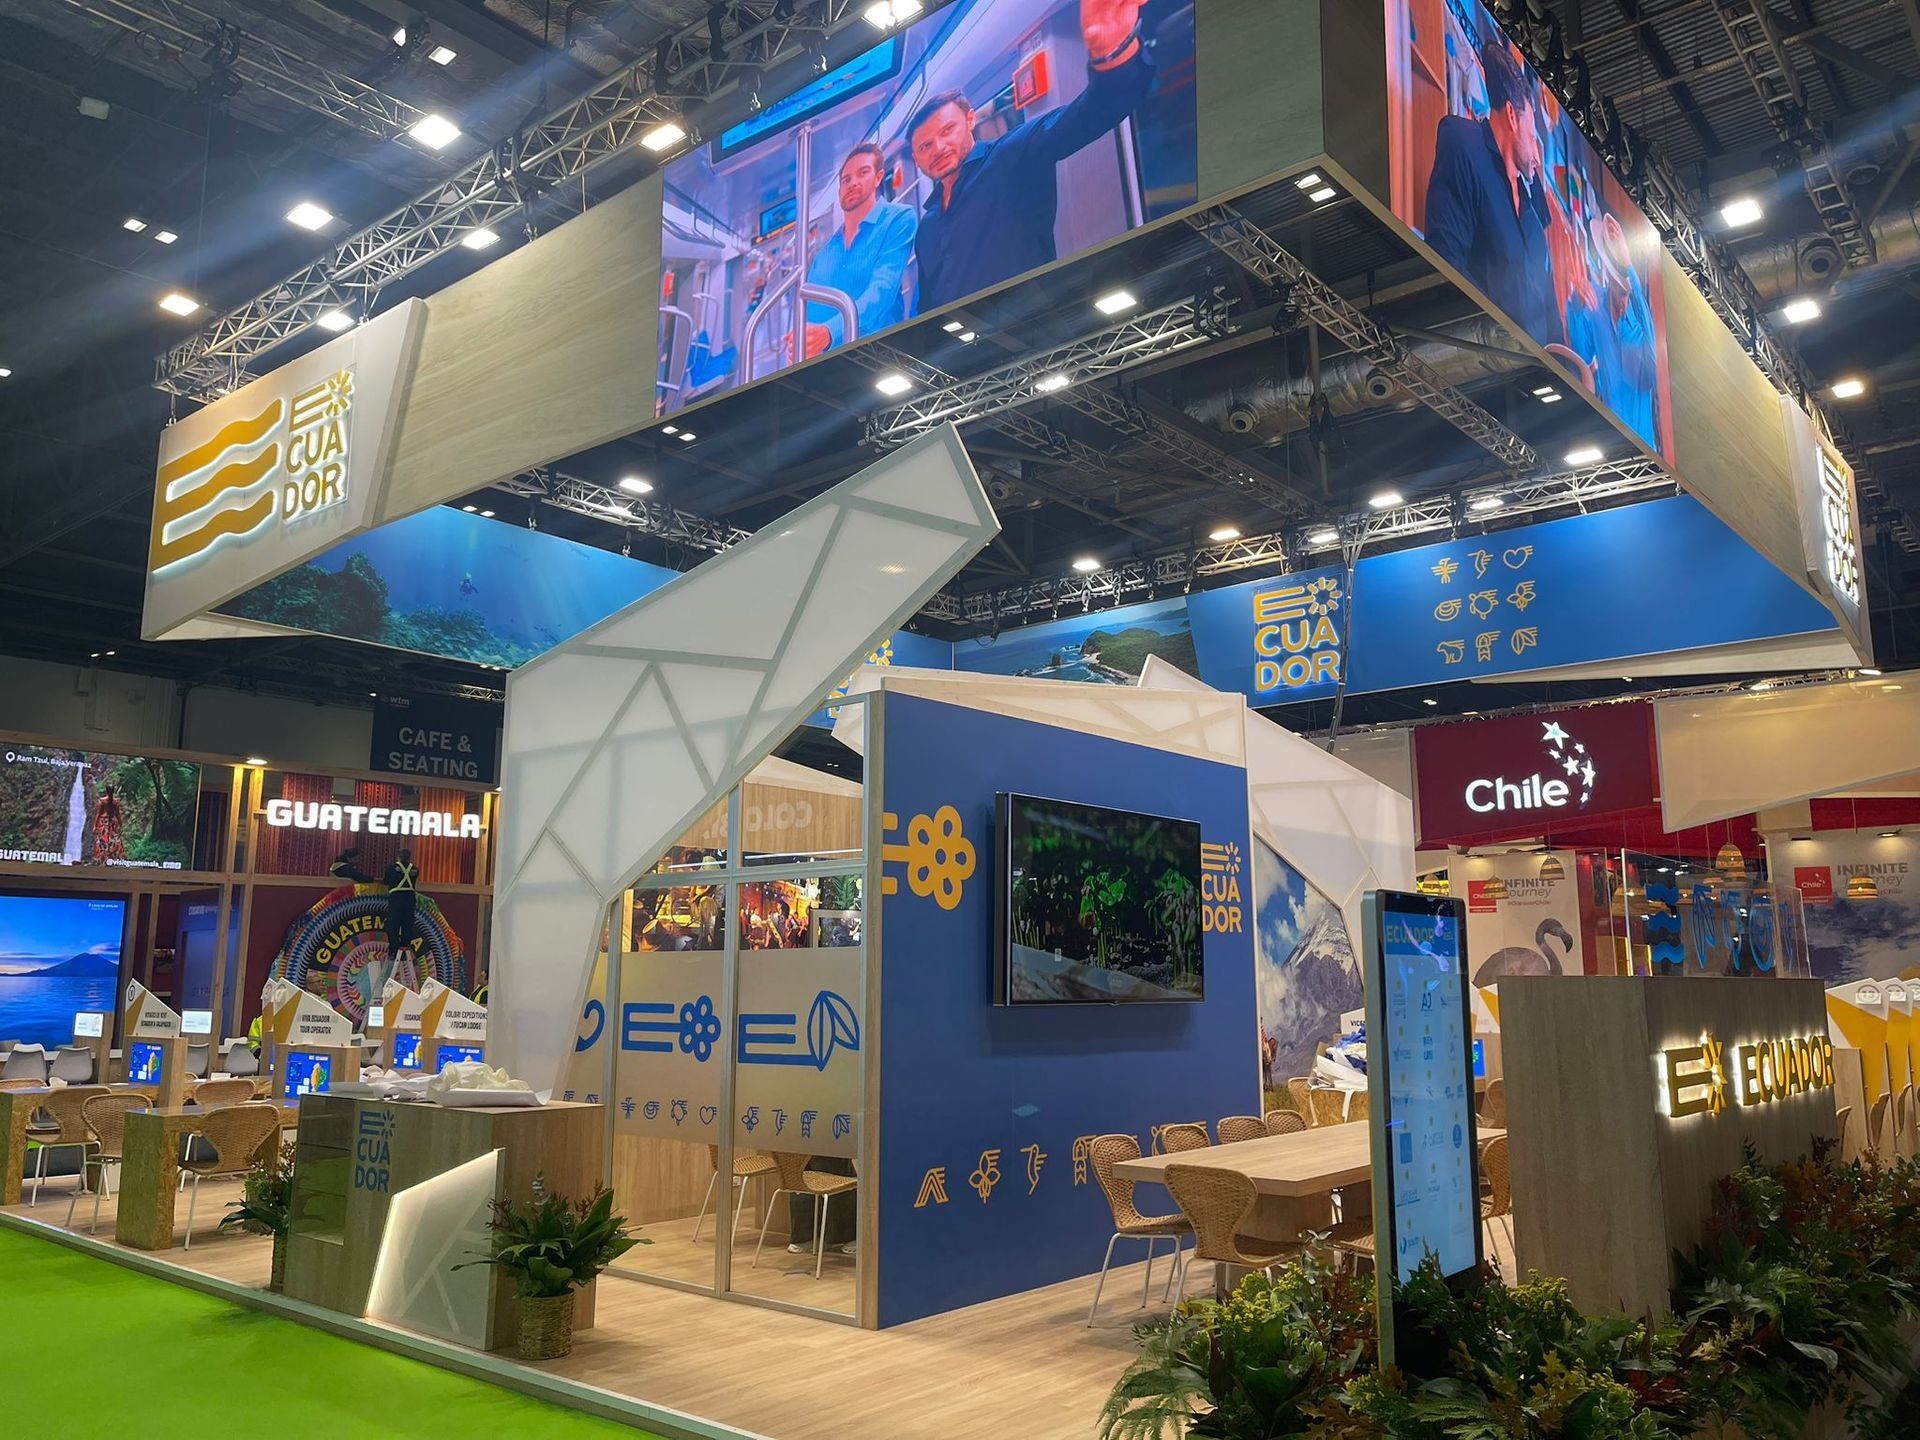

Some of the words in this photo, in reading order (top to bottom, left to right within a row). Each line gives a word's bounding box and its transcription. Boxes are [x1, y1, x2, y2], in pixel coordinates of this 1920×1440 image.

[1254, 616, 1340, 657] CUA
[1254, 650, 1341, 692] DOR
[399, 727, 453, 751] CAFE
[457, 735, 472, 753] &
[388, 751, 479, 779] SEATING
[1465, 773, 1569, 813] Chile
[266, 798, 480, 839] GUATEMALA
[1837, 862, 1909, 876] INFINITE
[1201, 873, 1241, 903] CUA
[1508, 887, 1552, 898] ourney
[1202, 904, 1242, 933] DOR
[1738, 1035, 1836, 1106] ECUADOR
[357, 1137, 391, 1165] CUA
[354, 1164, 391, 1194] DOR
